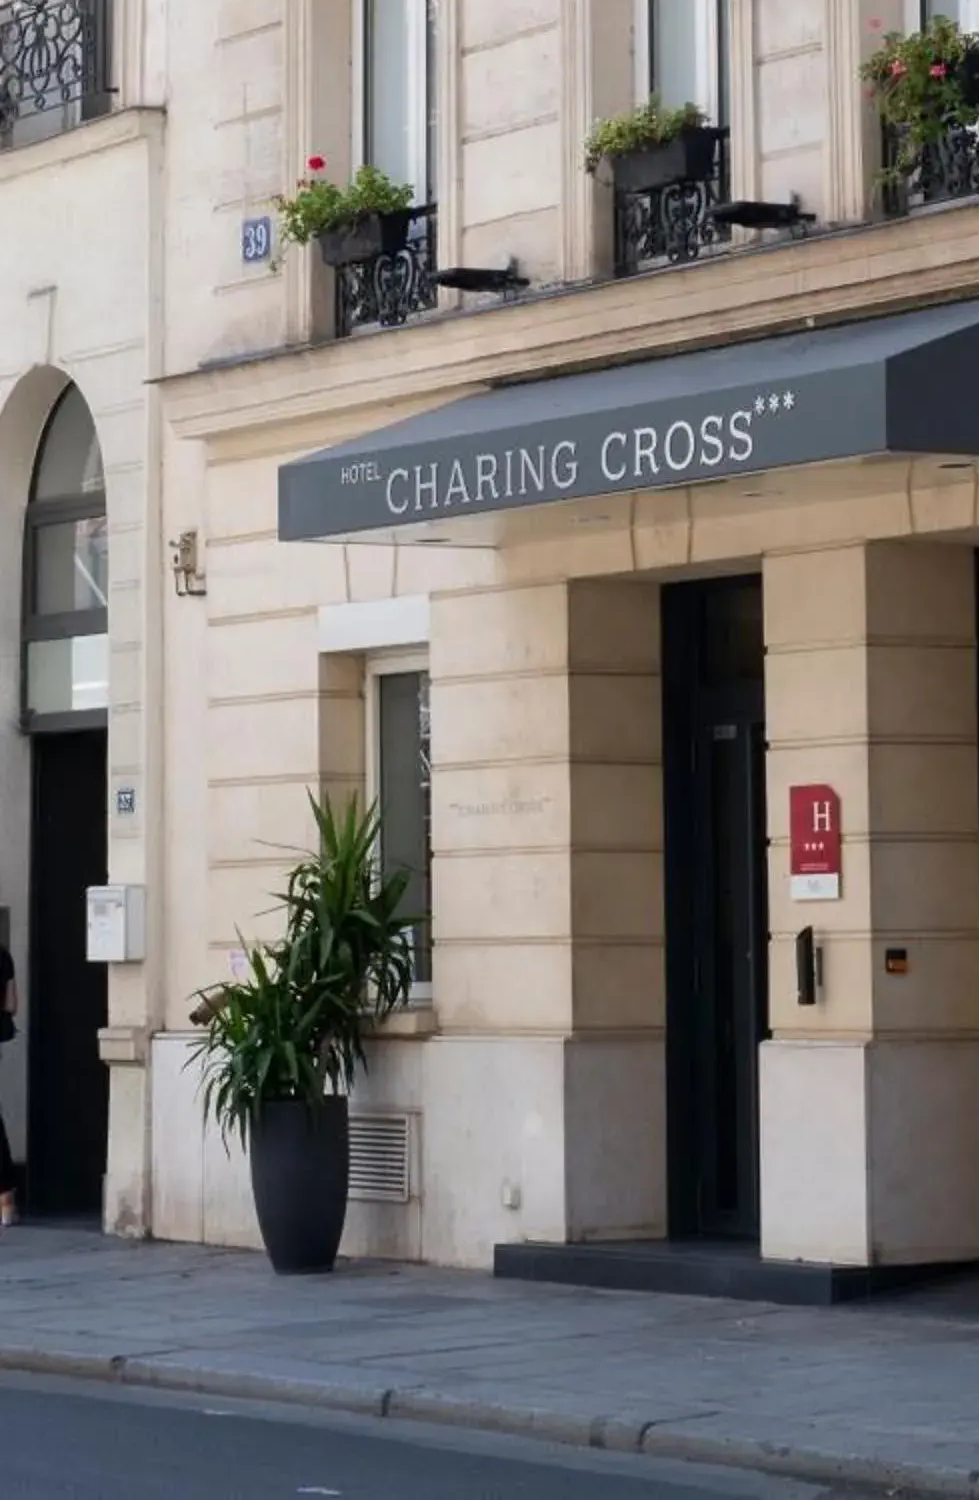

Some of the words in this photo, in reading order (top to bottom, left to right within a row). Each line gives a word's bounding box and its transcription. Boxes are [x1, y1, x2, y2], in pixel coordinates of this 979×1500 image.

[245, 224, 267, 257] 39
[386, 441, 579, 515] CHARING
[601, 410, 754, 481] CROSS
[813, 801, 830, 833] H
